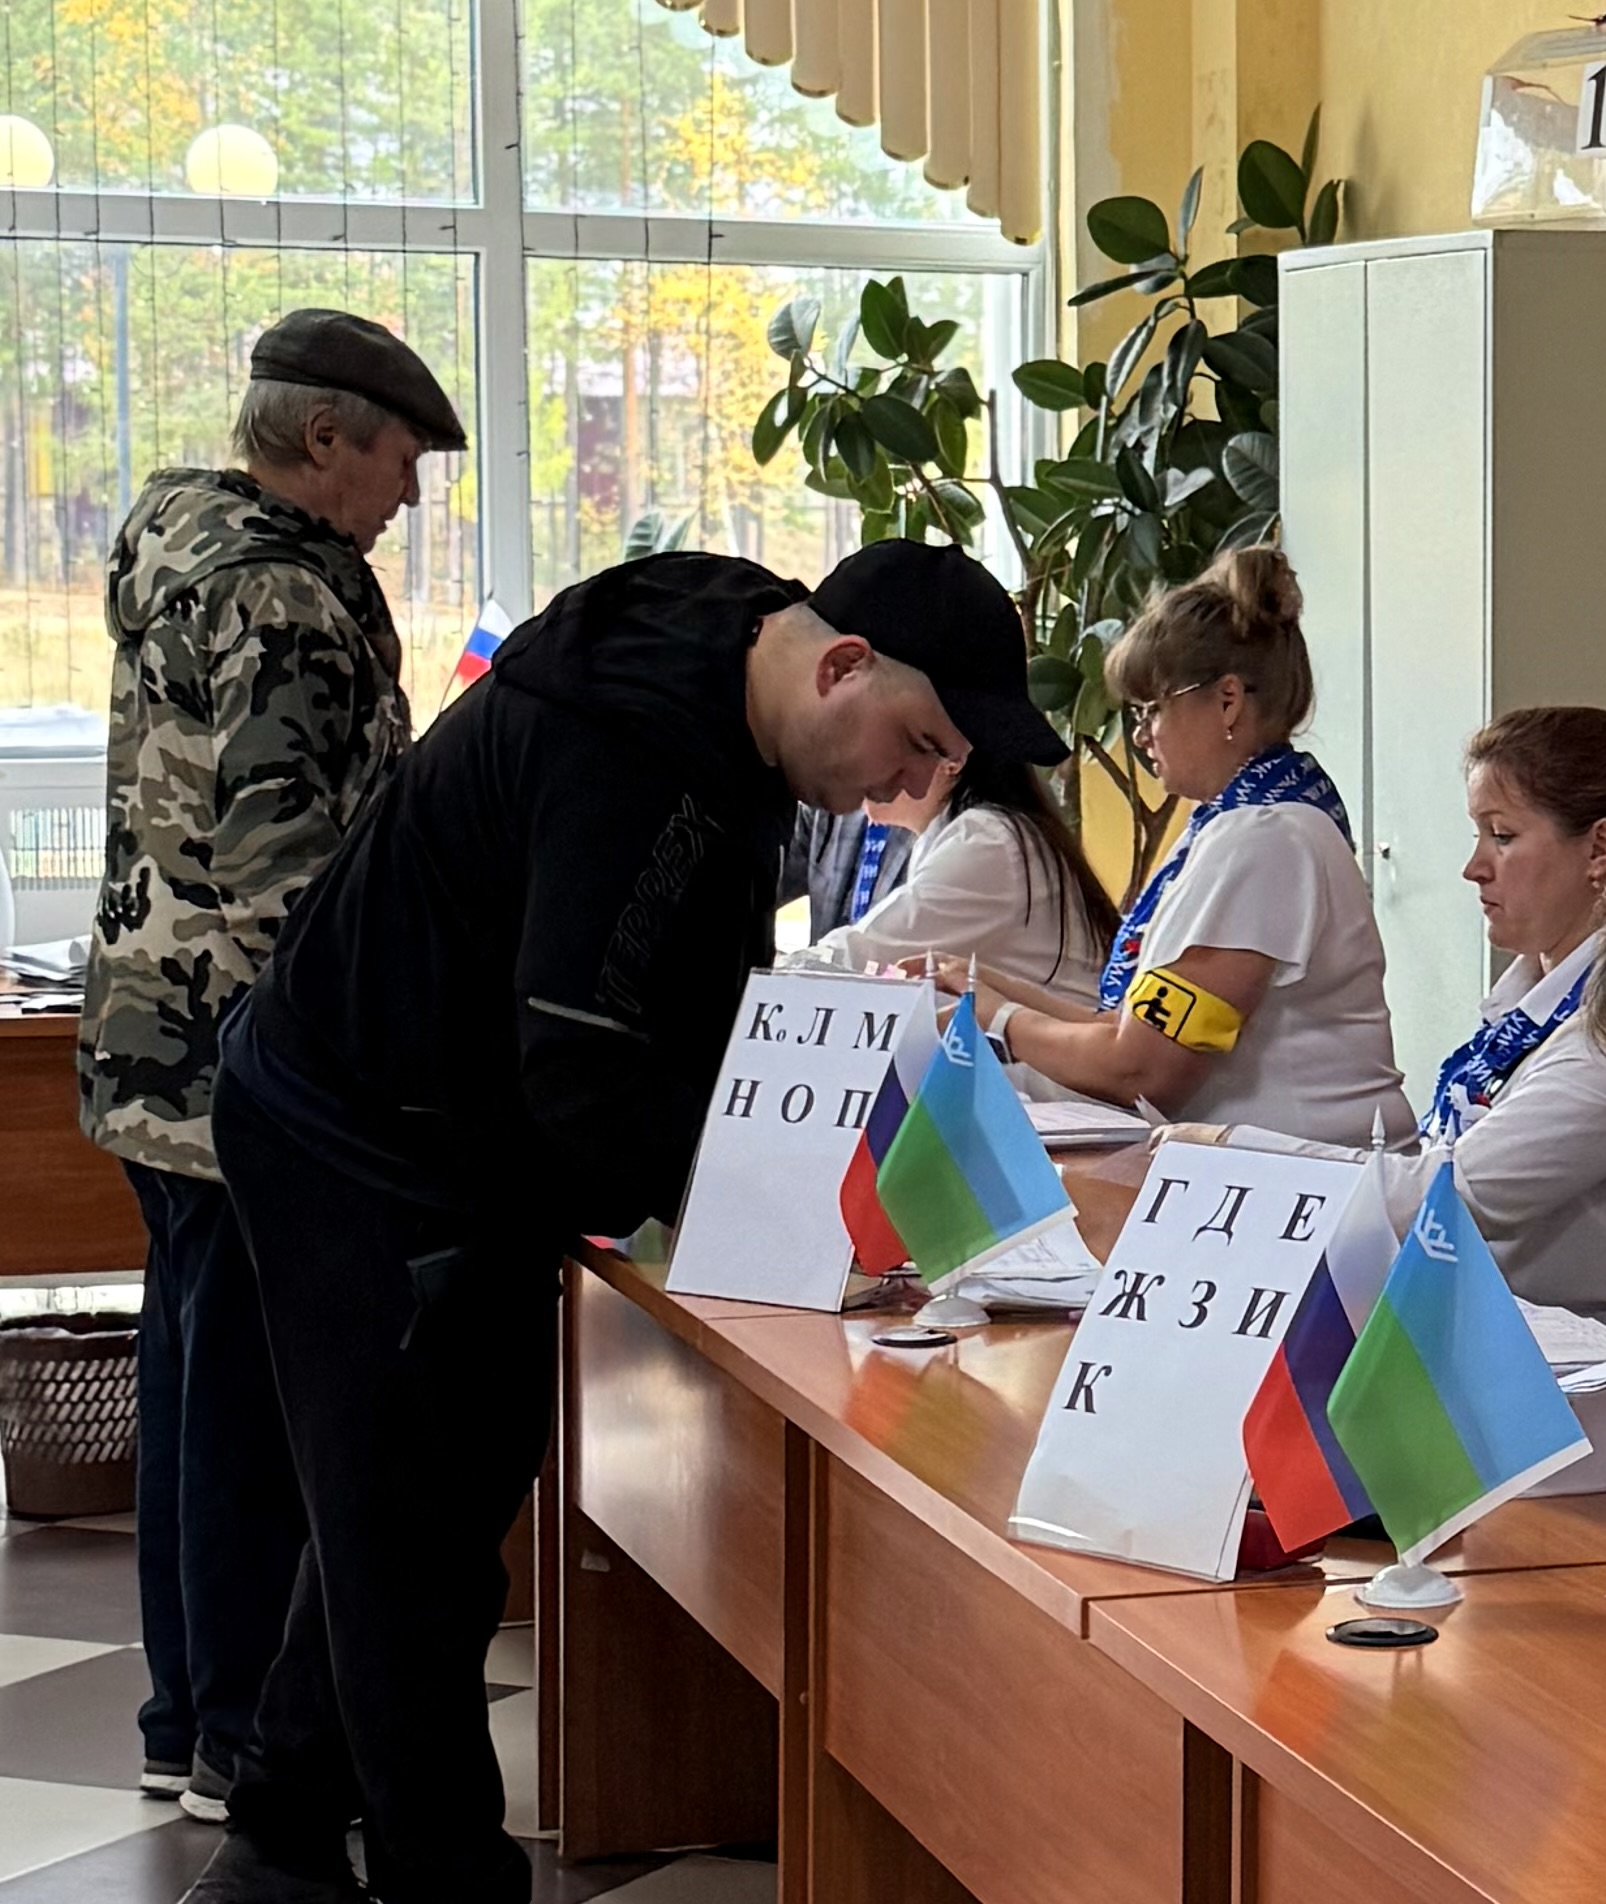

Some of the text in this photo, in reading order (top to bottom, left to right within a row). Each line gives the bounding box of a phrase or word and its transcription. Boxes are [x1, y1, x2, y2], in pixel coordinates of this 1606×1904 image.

[797, 1006, 838, 1046] Л
[852, 1011, 901, 1052] М
[723, 1078, 875, 1129] Н О П
[1142, 1177, 1327, 1245] Г Д Е
[1098, 1268, 1292, 1339] Ж З И
[1063, 1360, 1113, 1415] К
